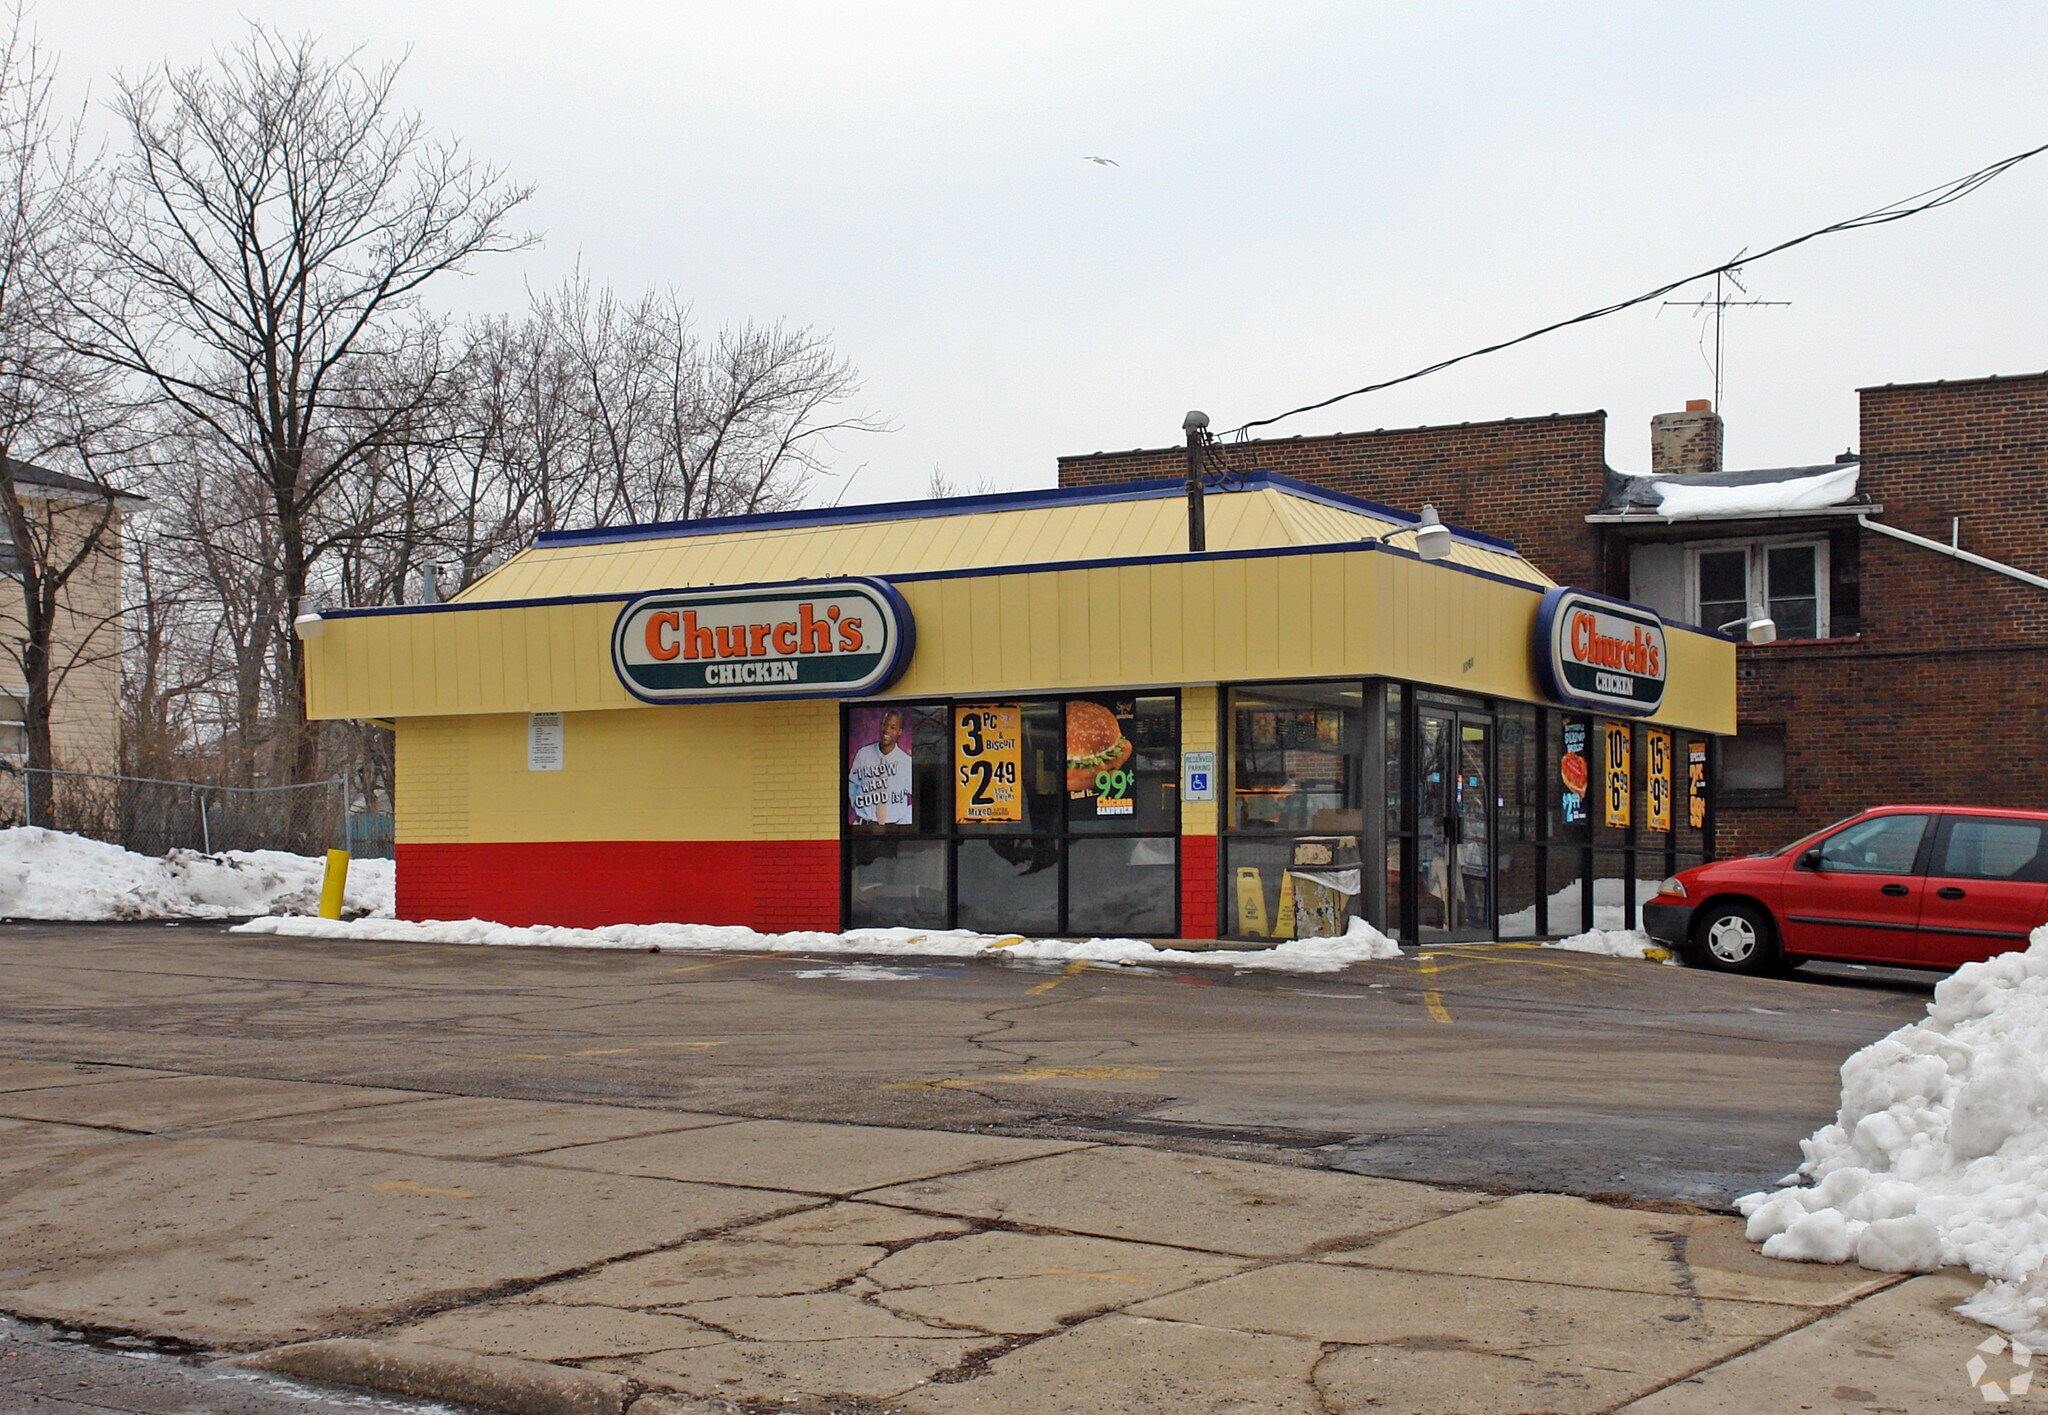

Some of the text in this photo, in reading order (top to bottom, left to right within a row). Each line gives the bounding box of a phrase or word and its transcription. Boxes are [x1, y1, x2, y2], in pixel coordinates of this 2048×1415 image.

[645, 603, 863, 661] Church's
[1571, 610, 1660, 677] Church's
[704, 660, 799, 685] CHICKEN
[1595, 672, 1634, 696] CHICKEN
[960, 713, 984, 758] 3
[983, 711, 998, 729] PC
[1607, 729, 1623, 770] 10
[1649, 736, 1664, 776] 15
[864, 761, 897, 778] KNOW
[1187, 764, 1211, 772] PARKING
[855, 791, 889, 808] GOOD
[1096, 796, 1134, 807] Chicken
